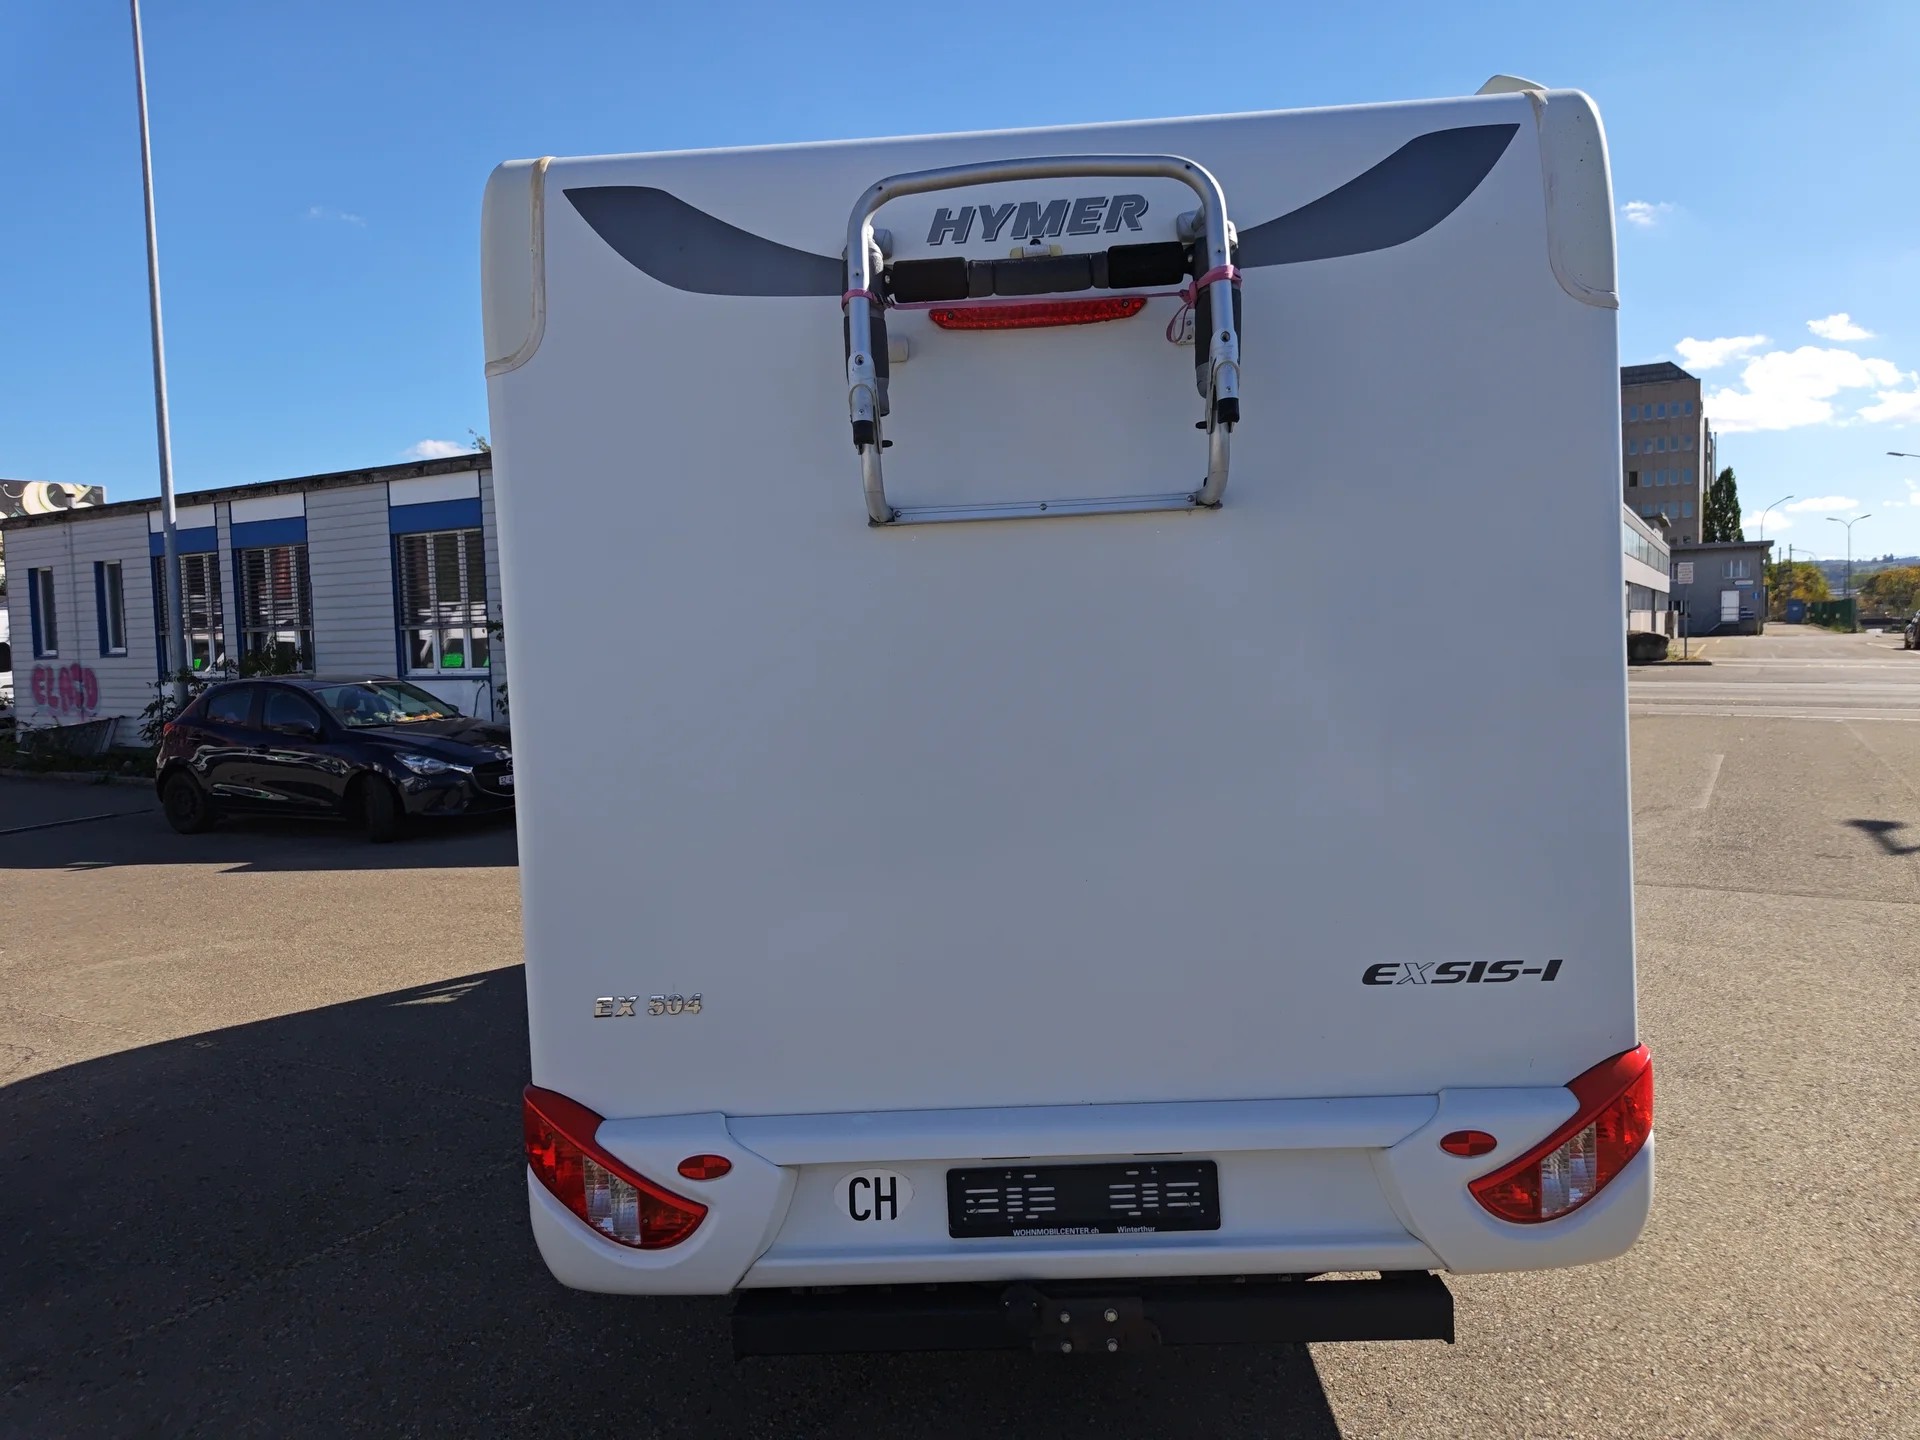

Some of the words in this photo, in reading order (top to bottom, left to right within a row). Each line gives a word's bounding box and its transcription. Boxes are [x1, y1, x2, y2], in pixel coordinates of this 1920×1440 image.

[926, 194, 1149, 247] HYMER
[1362, 959, 1563, 985] EXSIS-I
[594, 995, 639, 1018] EX
[647, 992, 702, 1016] 504
[848, 1176, 898, 1222] CH
[1012, 1227, 1100, 1237] WOHNMOBILCENTER.ch
[1116, 1225, 1156, 1234] Winterthur
